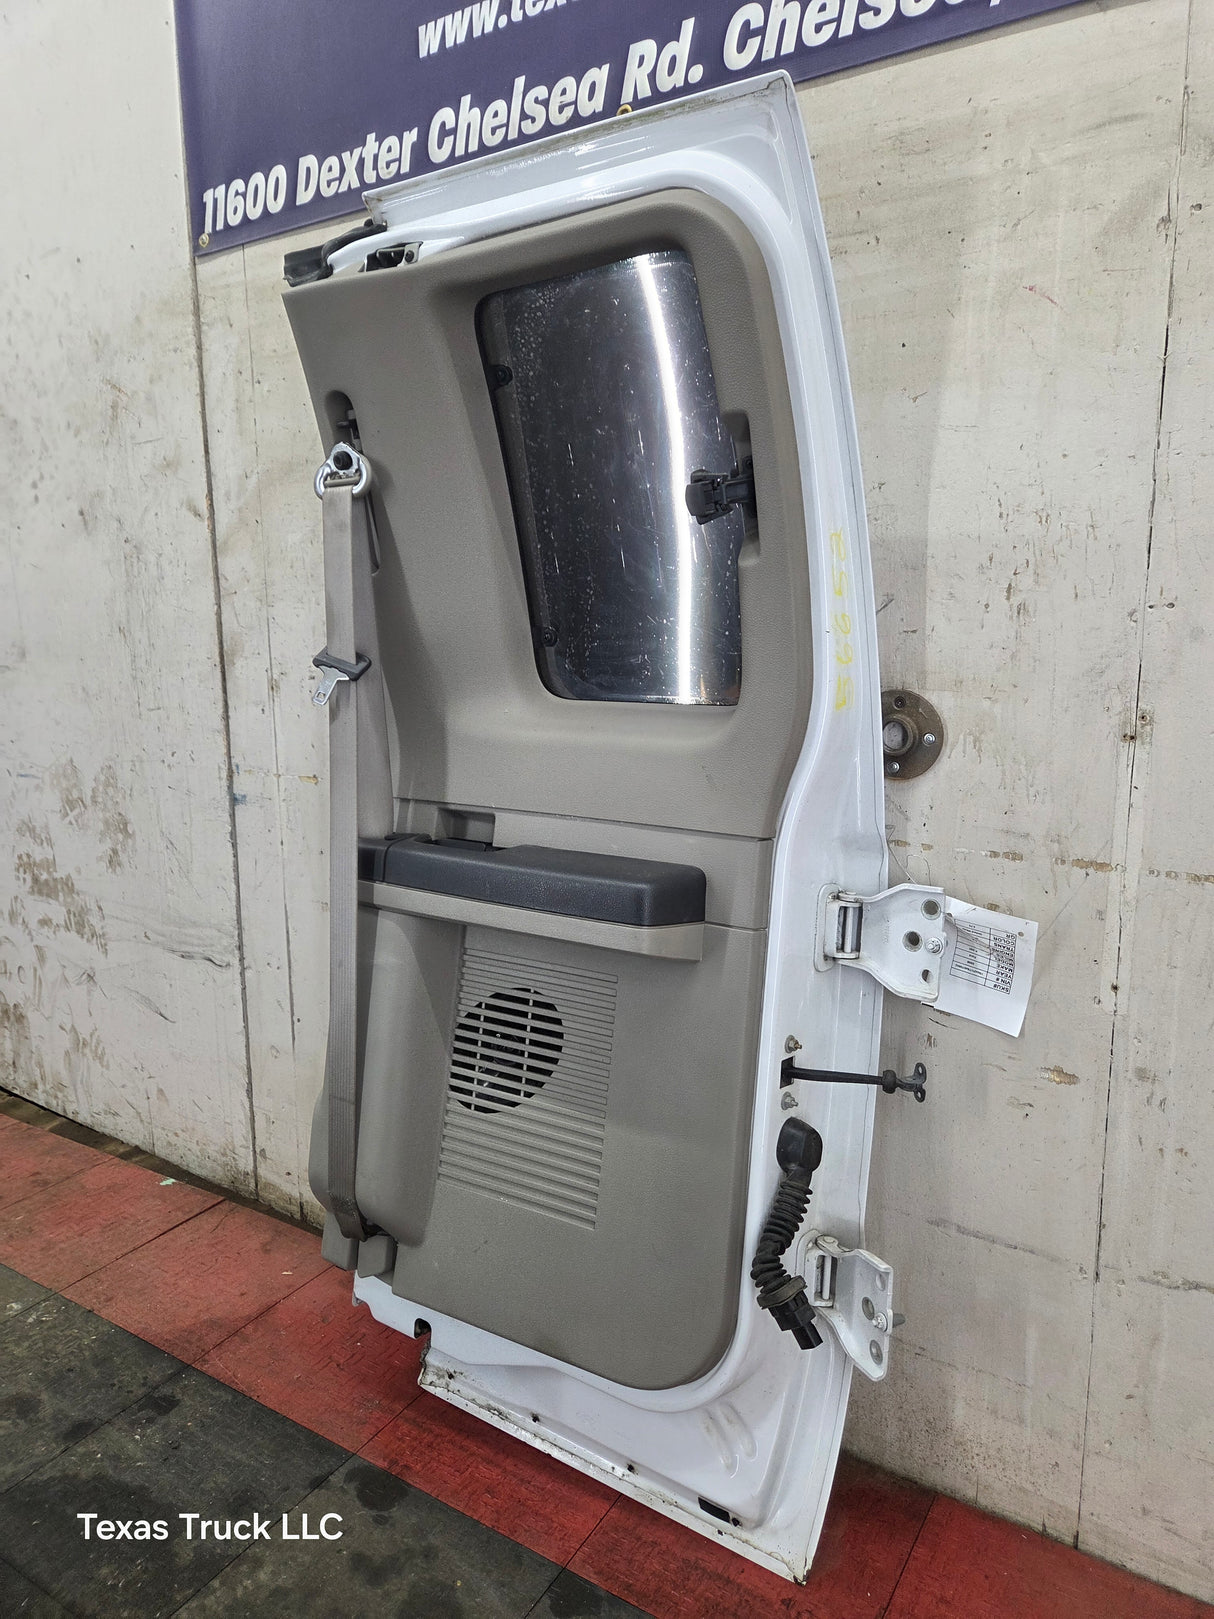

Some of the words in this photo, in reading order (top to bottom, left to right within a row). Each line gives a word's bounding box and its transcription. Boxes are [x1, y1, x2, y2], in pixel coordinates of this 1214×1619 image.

[202, 164, 287, 234] 11600
[296, 126, 419, 206] Dexter
[427, 62, 610, 165] Chelsea
[619, 17, 703, 104] Rd.
[993, 936, 1015, 945] COLOR
[993, 942, 1014, 952] TRANS
[997, 964, 1013, 973] MAKE
[996, 971, 1012, 979] YEAR
